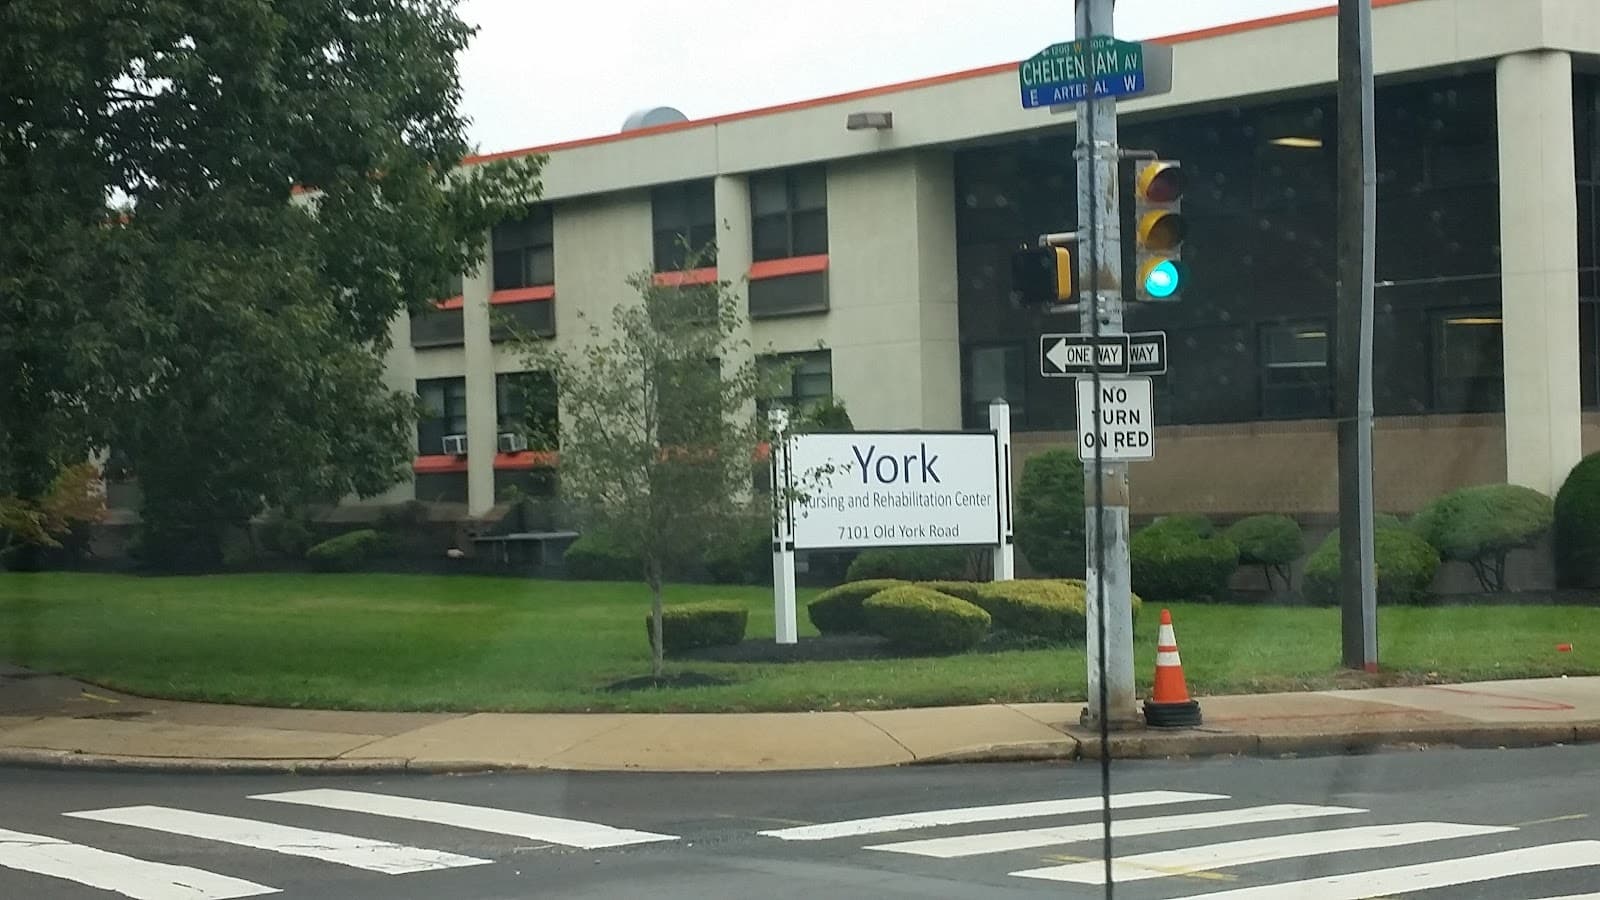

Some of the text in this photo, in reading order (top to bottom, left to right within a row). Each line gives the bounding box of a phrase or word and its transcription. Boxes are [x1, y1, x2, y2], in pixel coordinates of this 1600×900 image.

[1125, 53, 1138, 71] AV
[1030, 75, 1137, 106] E ARTERAL W
[1067, 347, 1090, 363] ONE
[1130, 346, 1154, 362] WAY
[1102, 388, 1127, 404] NO
[1092, 409, 1140, 425] URN
[1084, 431, 1149, 448] ON RED
[851, 442, 941, 484] York
[848, 491, 870, 508] and
[873, 491, 952, 508] Rehabilitation
[955, 490, 992, 507] Center
[837, 523, 960, 540] 7101 Old York Road
